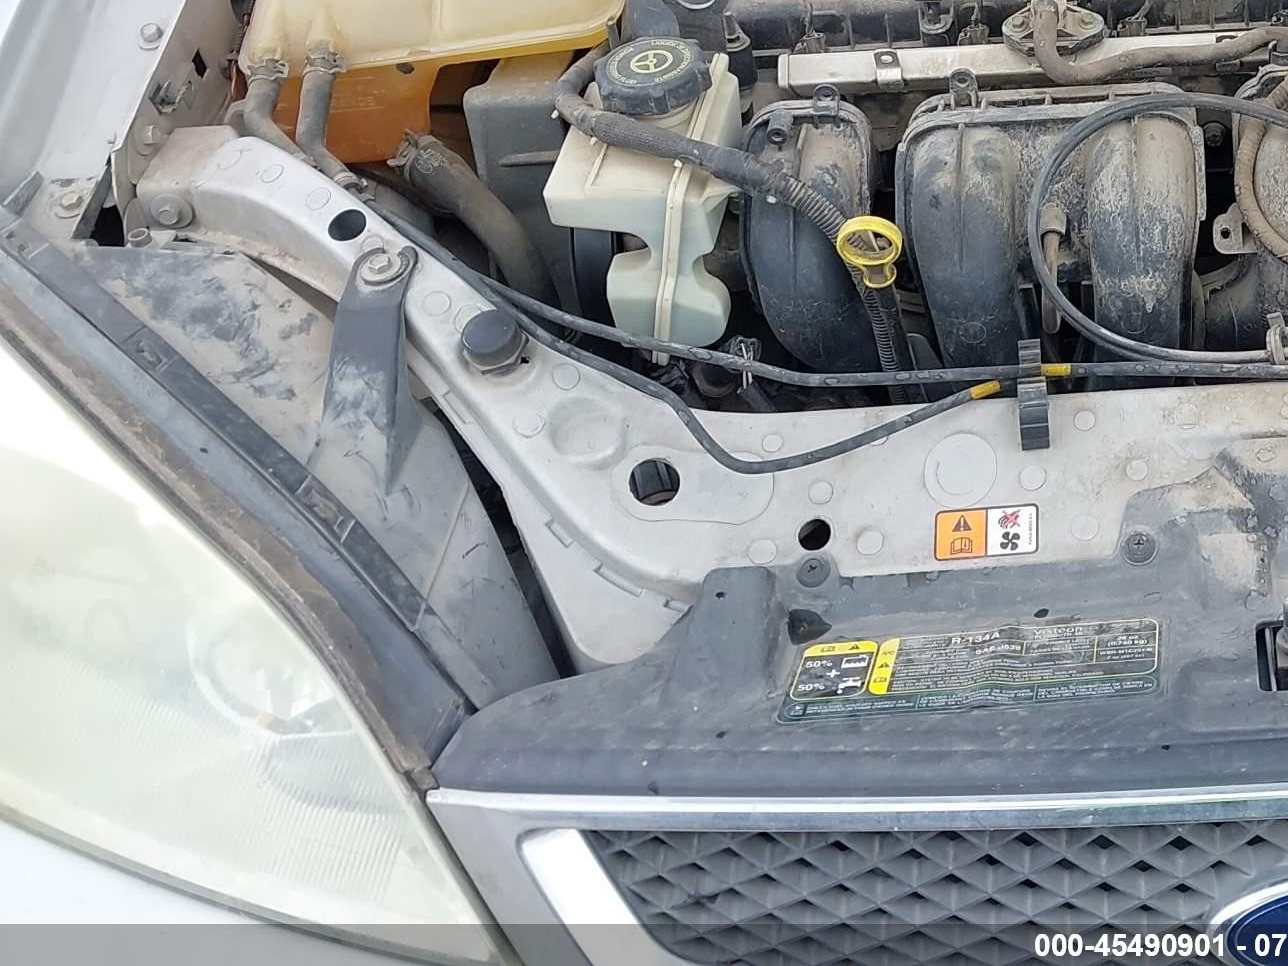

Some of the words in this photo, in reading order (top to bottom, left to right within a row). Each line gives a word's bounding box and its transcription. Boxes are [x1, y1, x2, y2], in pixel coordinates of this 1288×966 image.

[1033, 626, 1083, 635] Visteon
[951, 631, 1001, 645] R-134A
[975, 645, 996, 655] SAE
[805, 660, 833, 668] 50%
[797, 682, 826, 692] 50%
